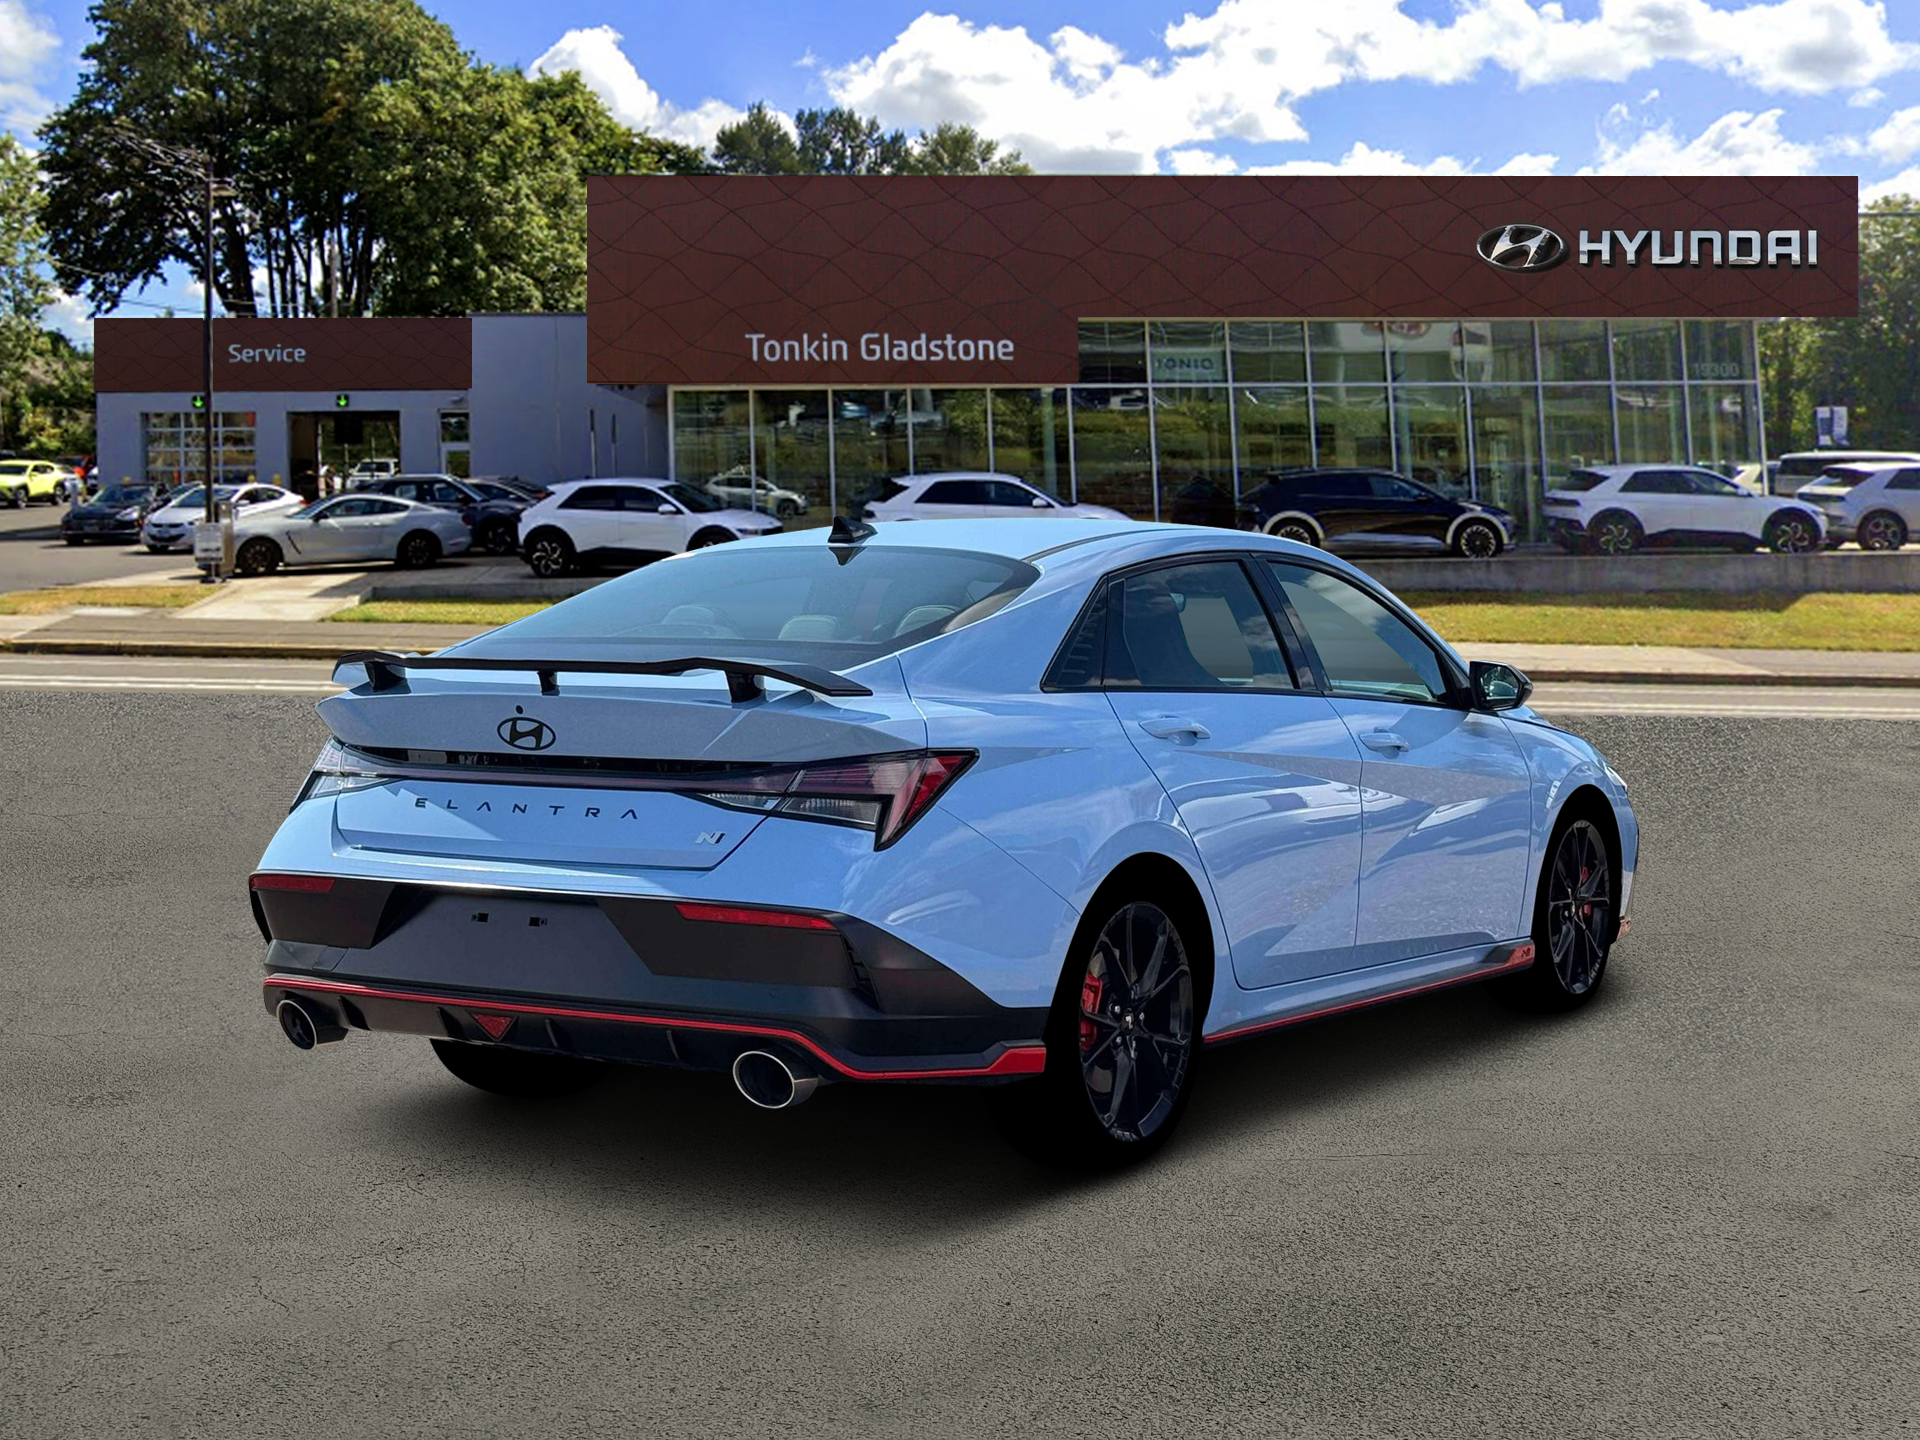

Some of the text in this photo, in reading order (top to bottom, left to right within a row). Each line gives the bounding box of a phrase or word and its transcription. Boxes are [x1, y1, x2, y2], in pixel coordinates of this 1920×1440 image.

[1578, 230, 1818, 265] HYUNDAI
[227, 343, 307, 363] Service
[745, 333, 1015, 362] Tonkin Gladstone
[414, 797, 639, 820] ELANTRA
